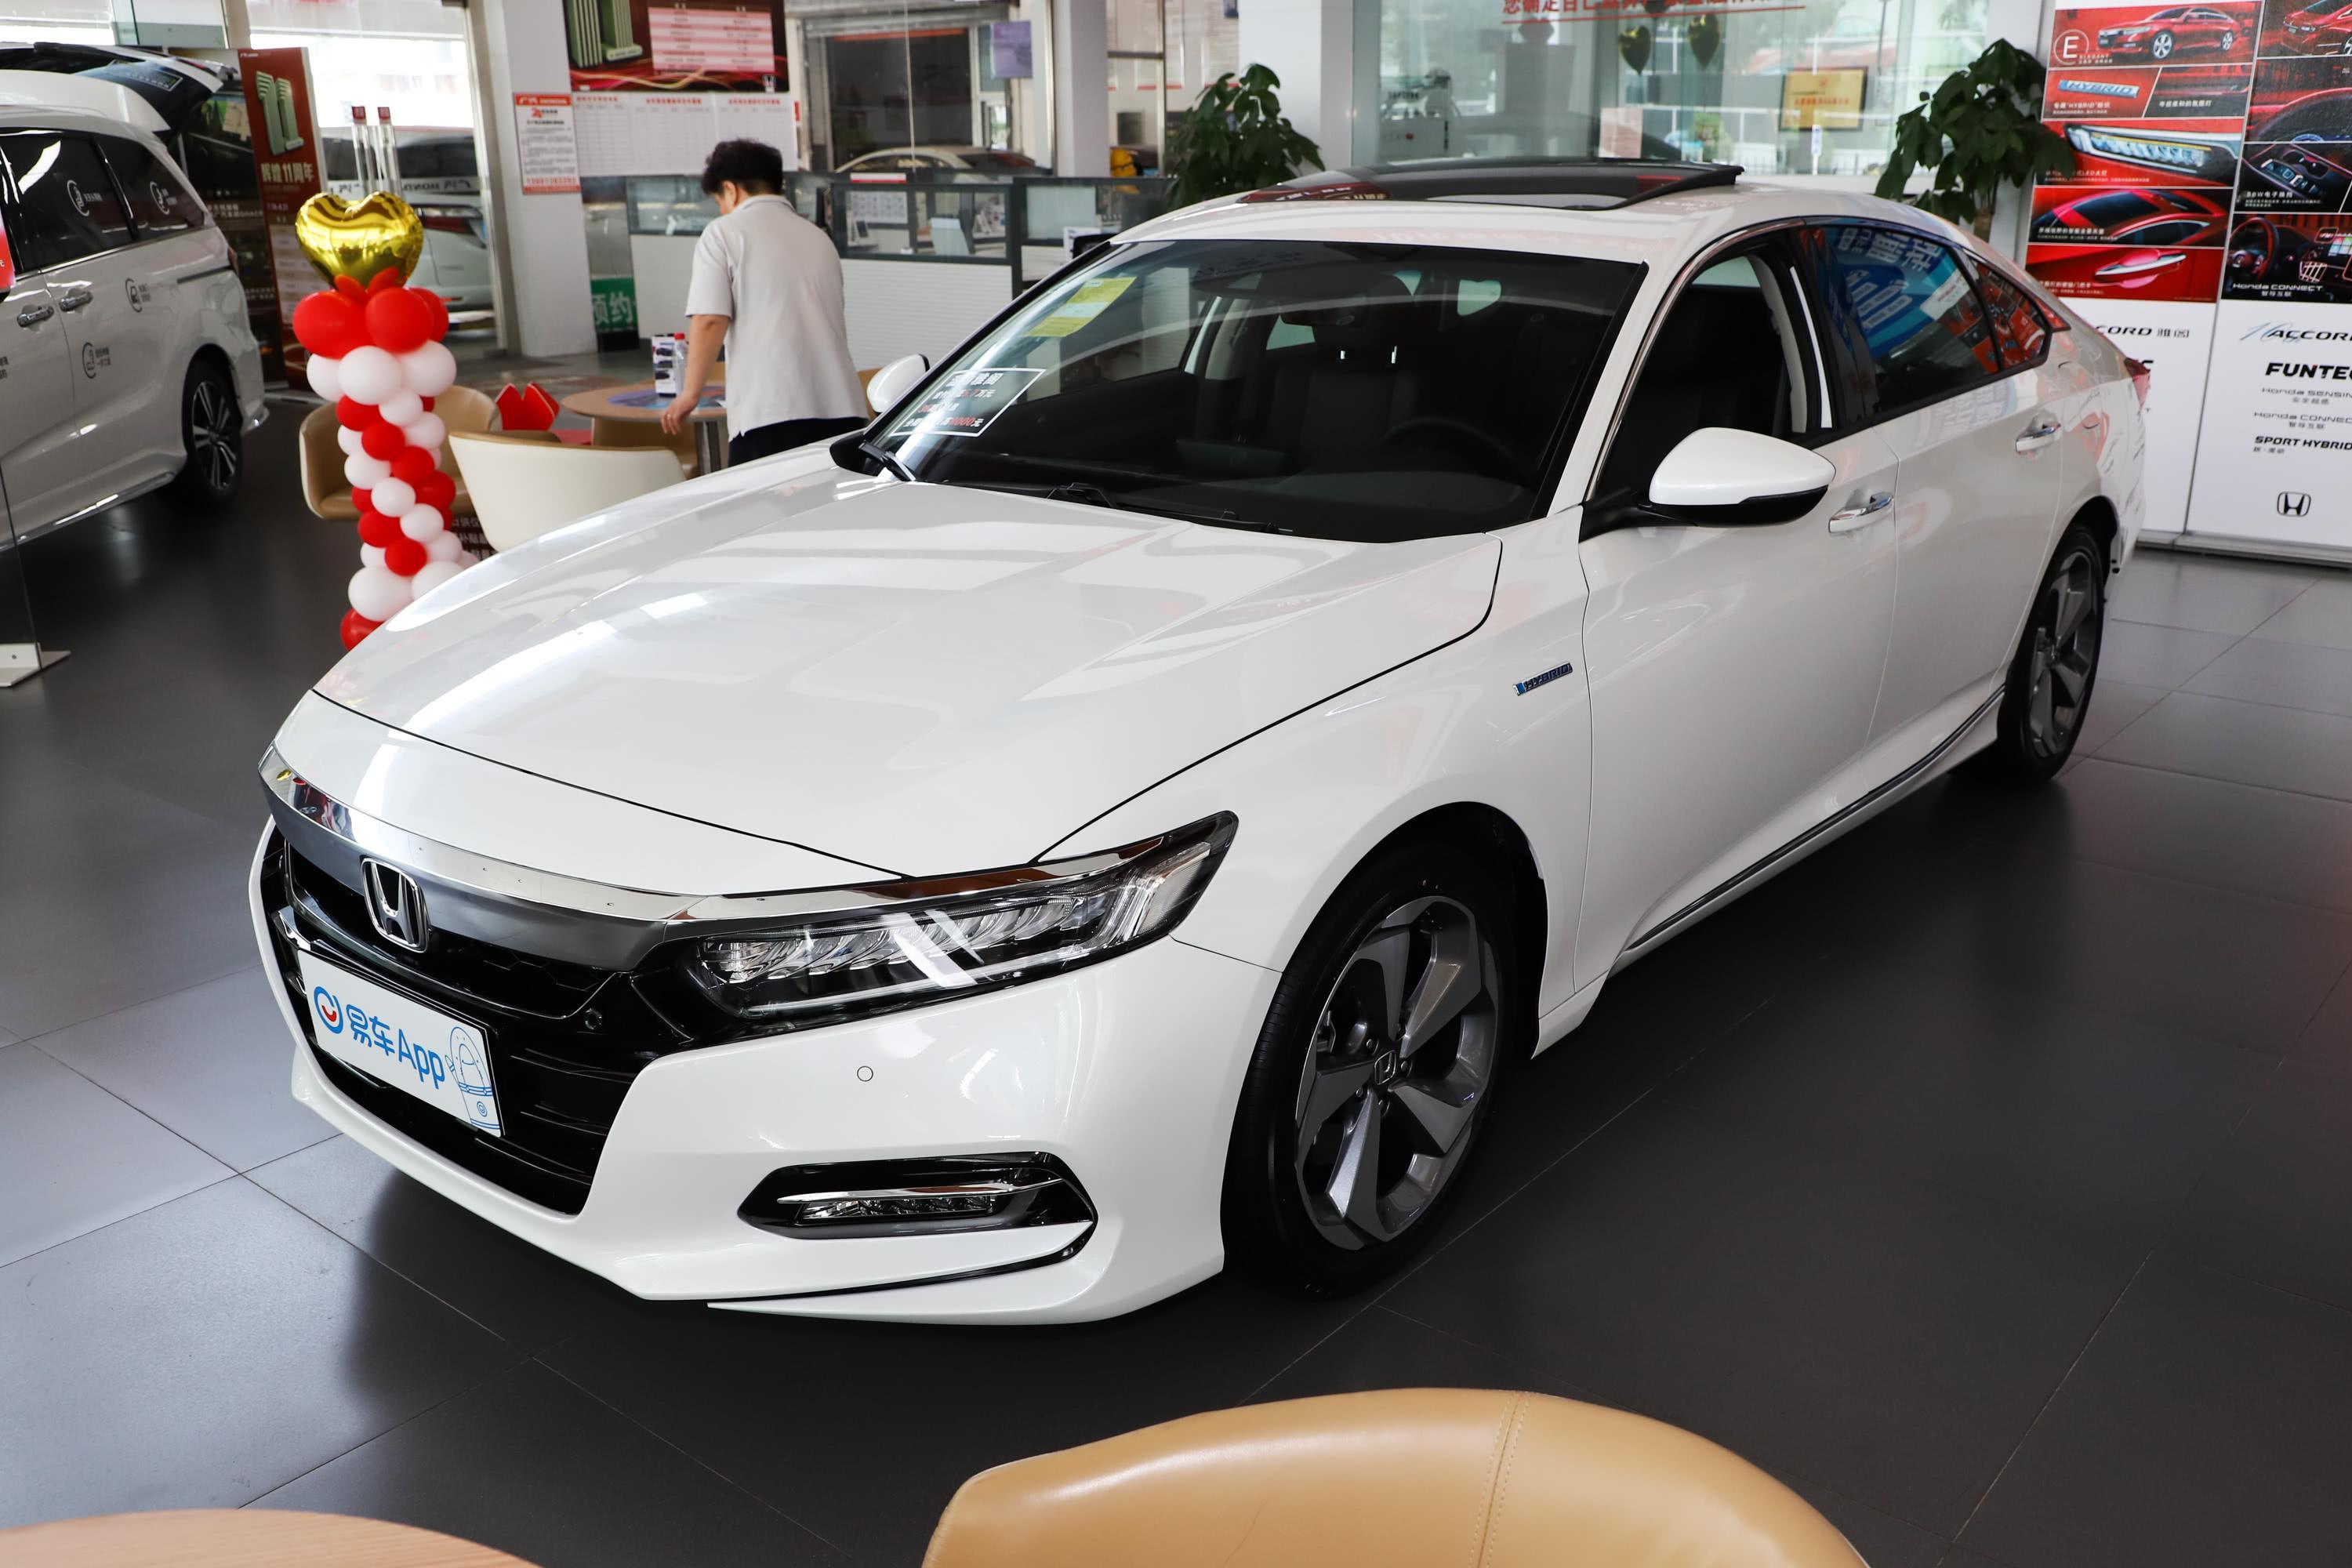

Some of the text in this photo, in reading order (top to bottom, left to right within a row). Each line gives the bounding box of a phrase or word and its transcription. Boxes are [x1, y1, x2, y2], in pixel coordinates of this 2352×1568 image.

[2062, 35, 2080, 59] E
[2064, 80, 2135, 96] HYBRID
[2267, 329, 2352, 342] ACCOR
[2255, 436, 2300, 445] SPORT
